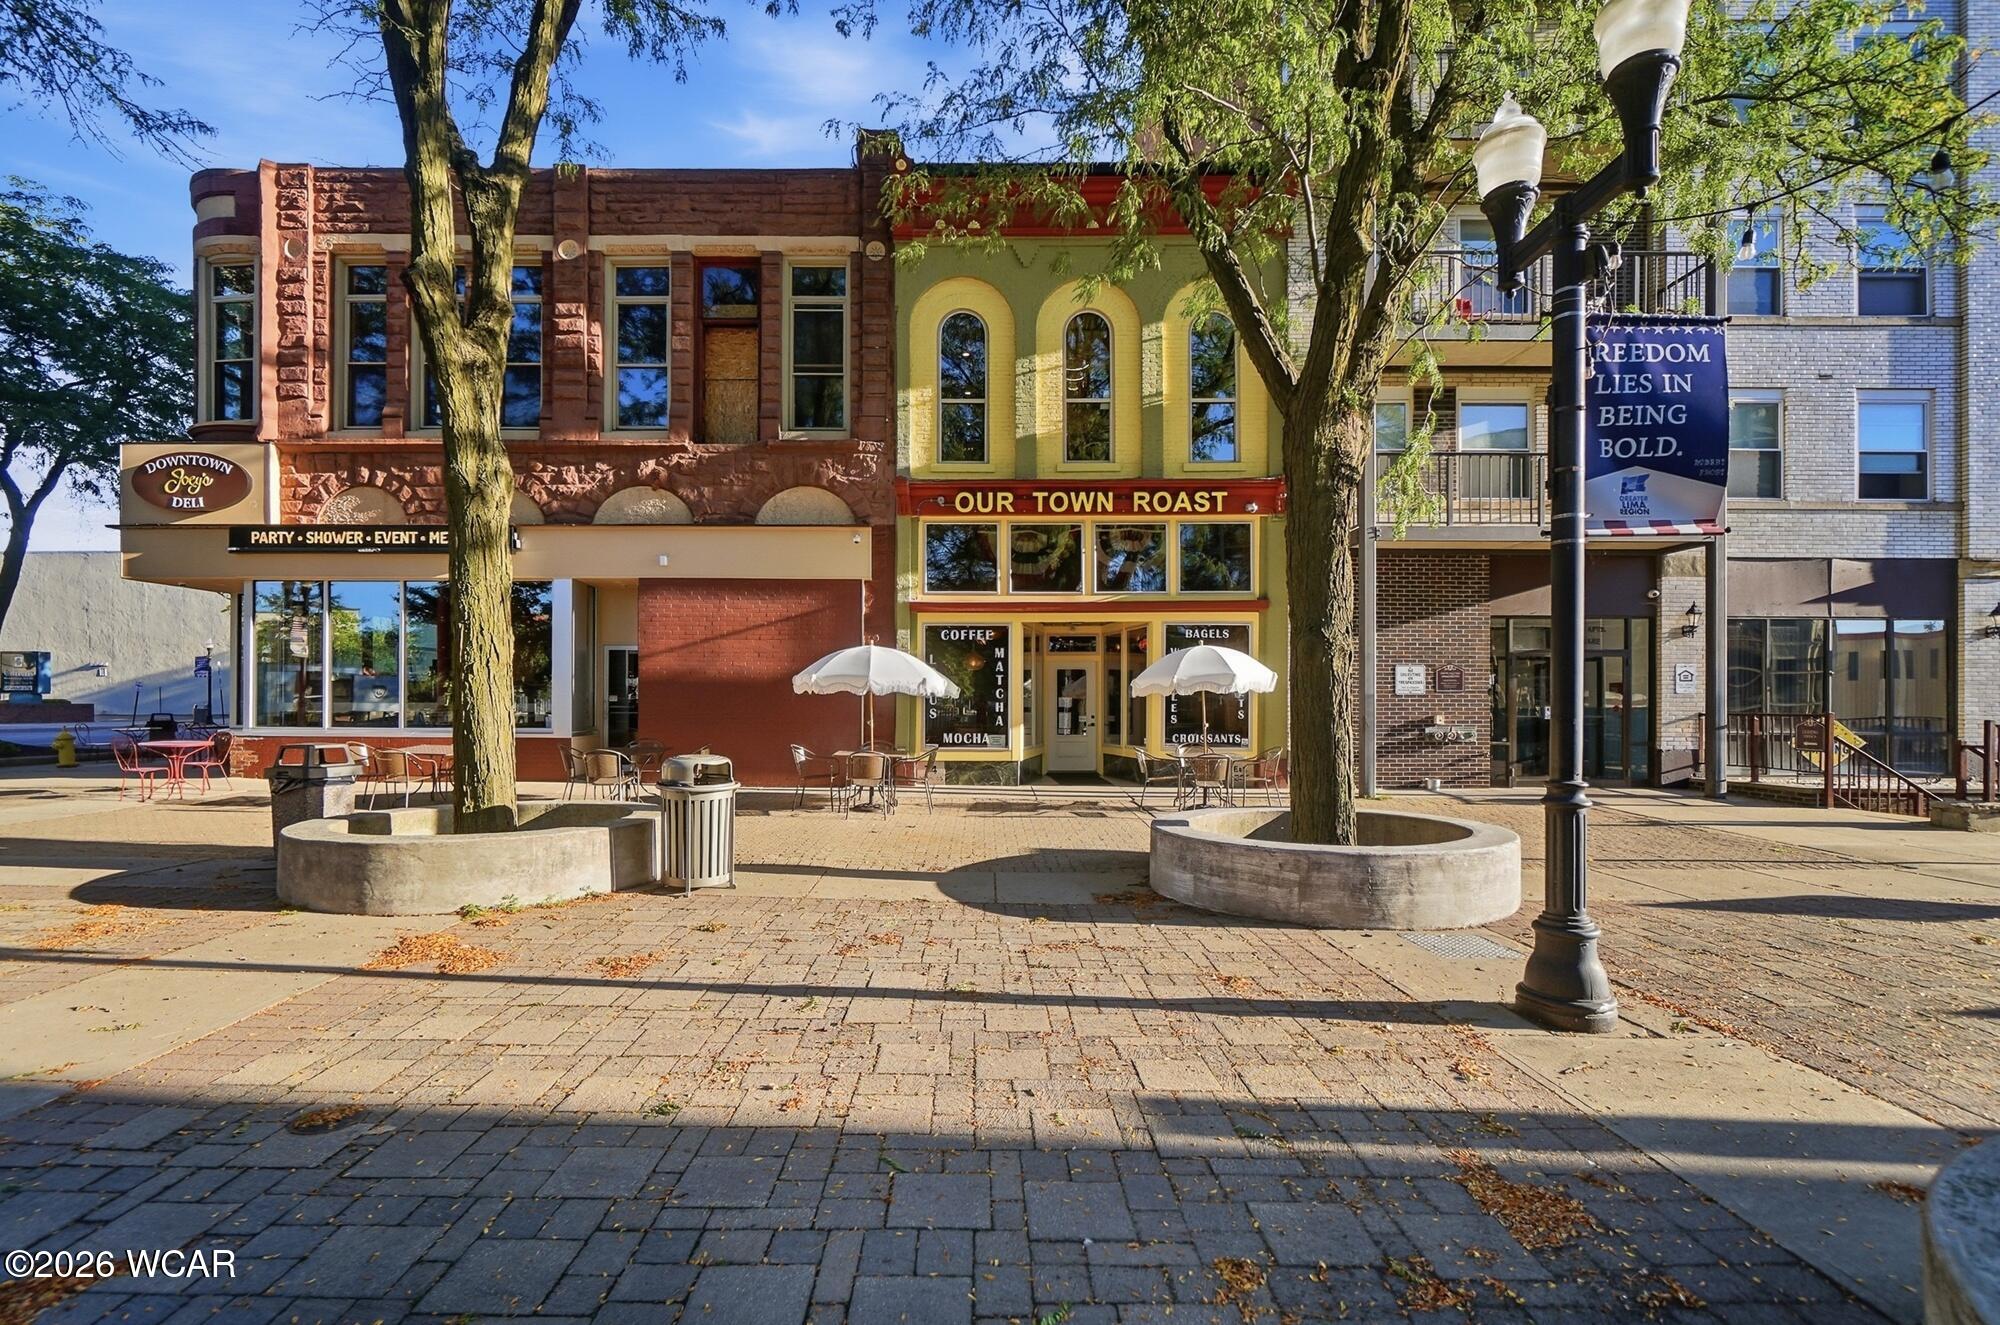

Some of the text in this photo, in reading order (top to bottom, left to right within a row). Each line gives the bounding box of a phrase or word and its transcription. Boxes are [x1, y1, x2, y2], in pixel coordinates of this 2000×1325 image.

[1594, 342, 1712, 363] REEDOM
[1594, 373, 1693, 395] LIES IN
[1597, 404, 1688, 427] BEING
[1598, 436, 1683, 459] BOLD.
[145, 454, 234, 475] DOWNTOWN
[163, 467, 214, 495] Joey's
[171, 496, 205, 509] DELI
[954, 491, 1228, 513] OUR TOWN ROAST
[1621, 501, 1647, 509] LIMA
[250, 531, 294, 545] PARTY
[305, 531, 363, 545] SHOWER
[374, 531, 417, 545] EVENT
[940, 629, 995, 641] COFFEE
[1185, 628, 1230, 639] BAGELS
[994, 647, 1005, 727] MATCHA
[943, 732, 991, 744] MOCHA
[1172, 733, 1241, 744] CROISSANTS
